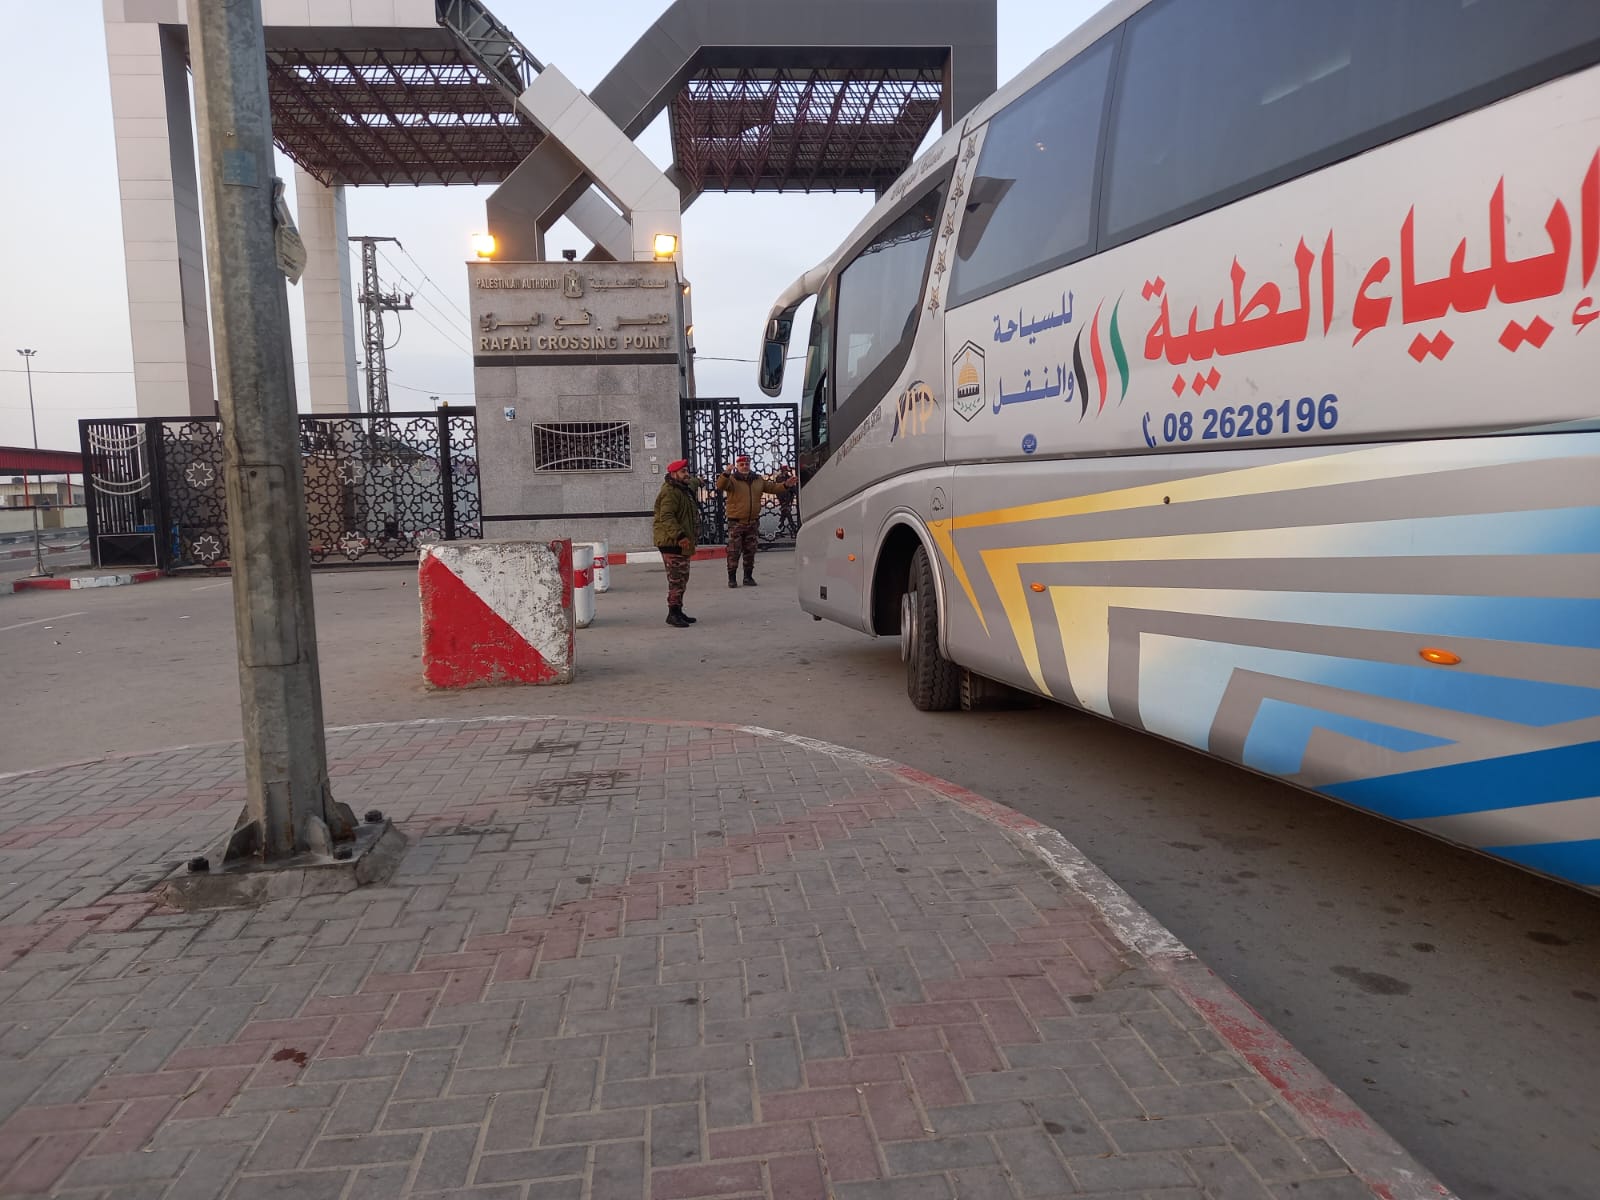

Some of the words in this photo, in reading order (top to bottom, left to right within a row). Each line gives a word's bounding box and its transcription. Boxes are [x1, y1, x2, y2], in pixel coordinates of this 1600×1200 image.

[522, 278, 560, 289] AUTHORITY
[993, 289, 1074, 344] للسياحة
[1141, 227, 1334, 398] الطبية
[480, 336, 531, 350] RAFAH
[537, 335, 617, 350] CROSSING
[623, 334, 671, 349] POINT
[992, 362, 1074, 415] والنقل
[1163, 413, 1193, 442] 08
[1202, 394, 1339, 440] 2628196
